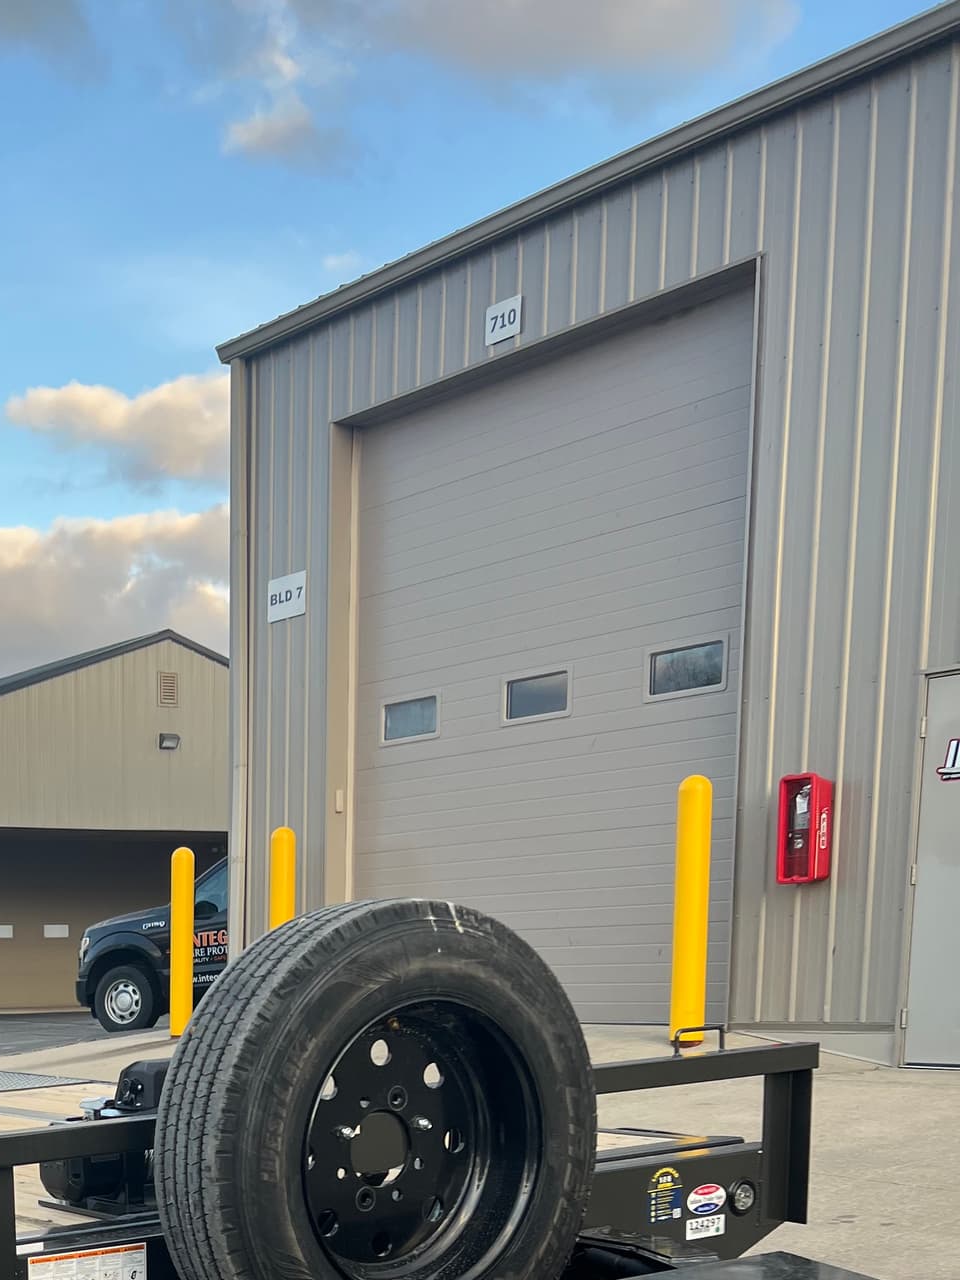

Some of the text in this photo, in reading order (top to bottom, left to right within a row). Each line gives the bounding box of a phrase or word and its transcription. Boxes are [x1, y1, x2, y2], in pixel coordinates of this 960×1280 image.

[490, 308, 517, 333] 710
[270, 586, 304, 607] BLD 7
